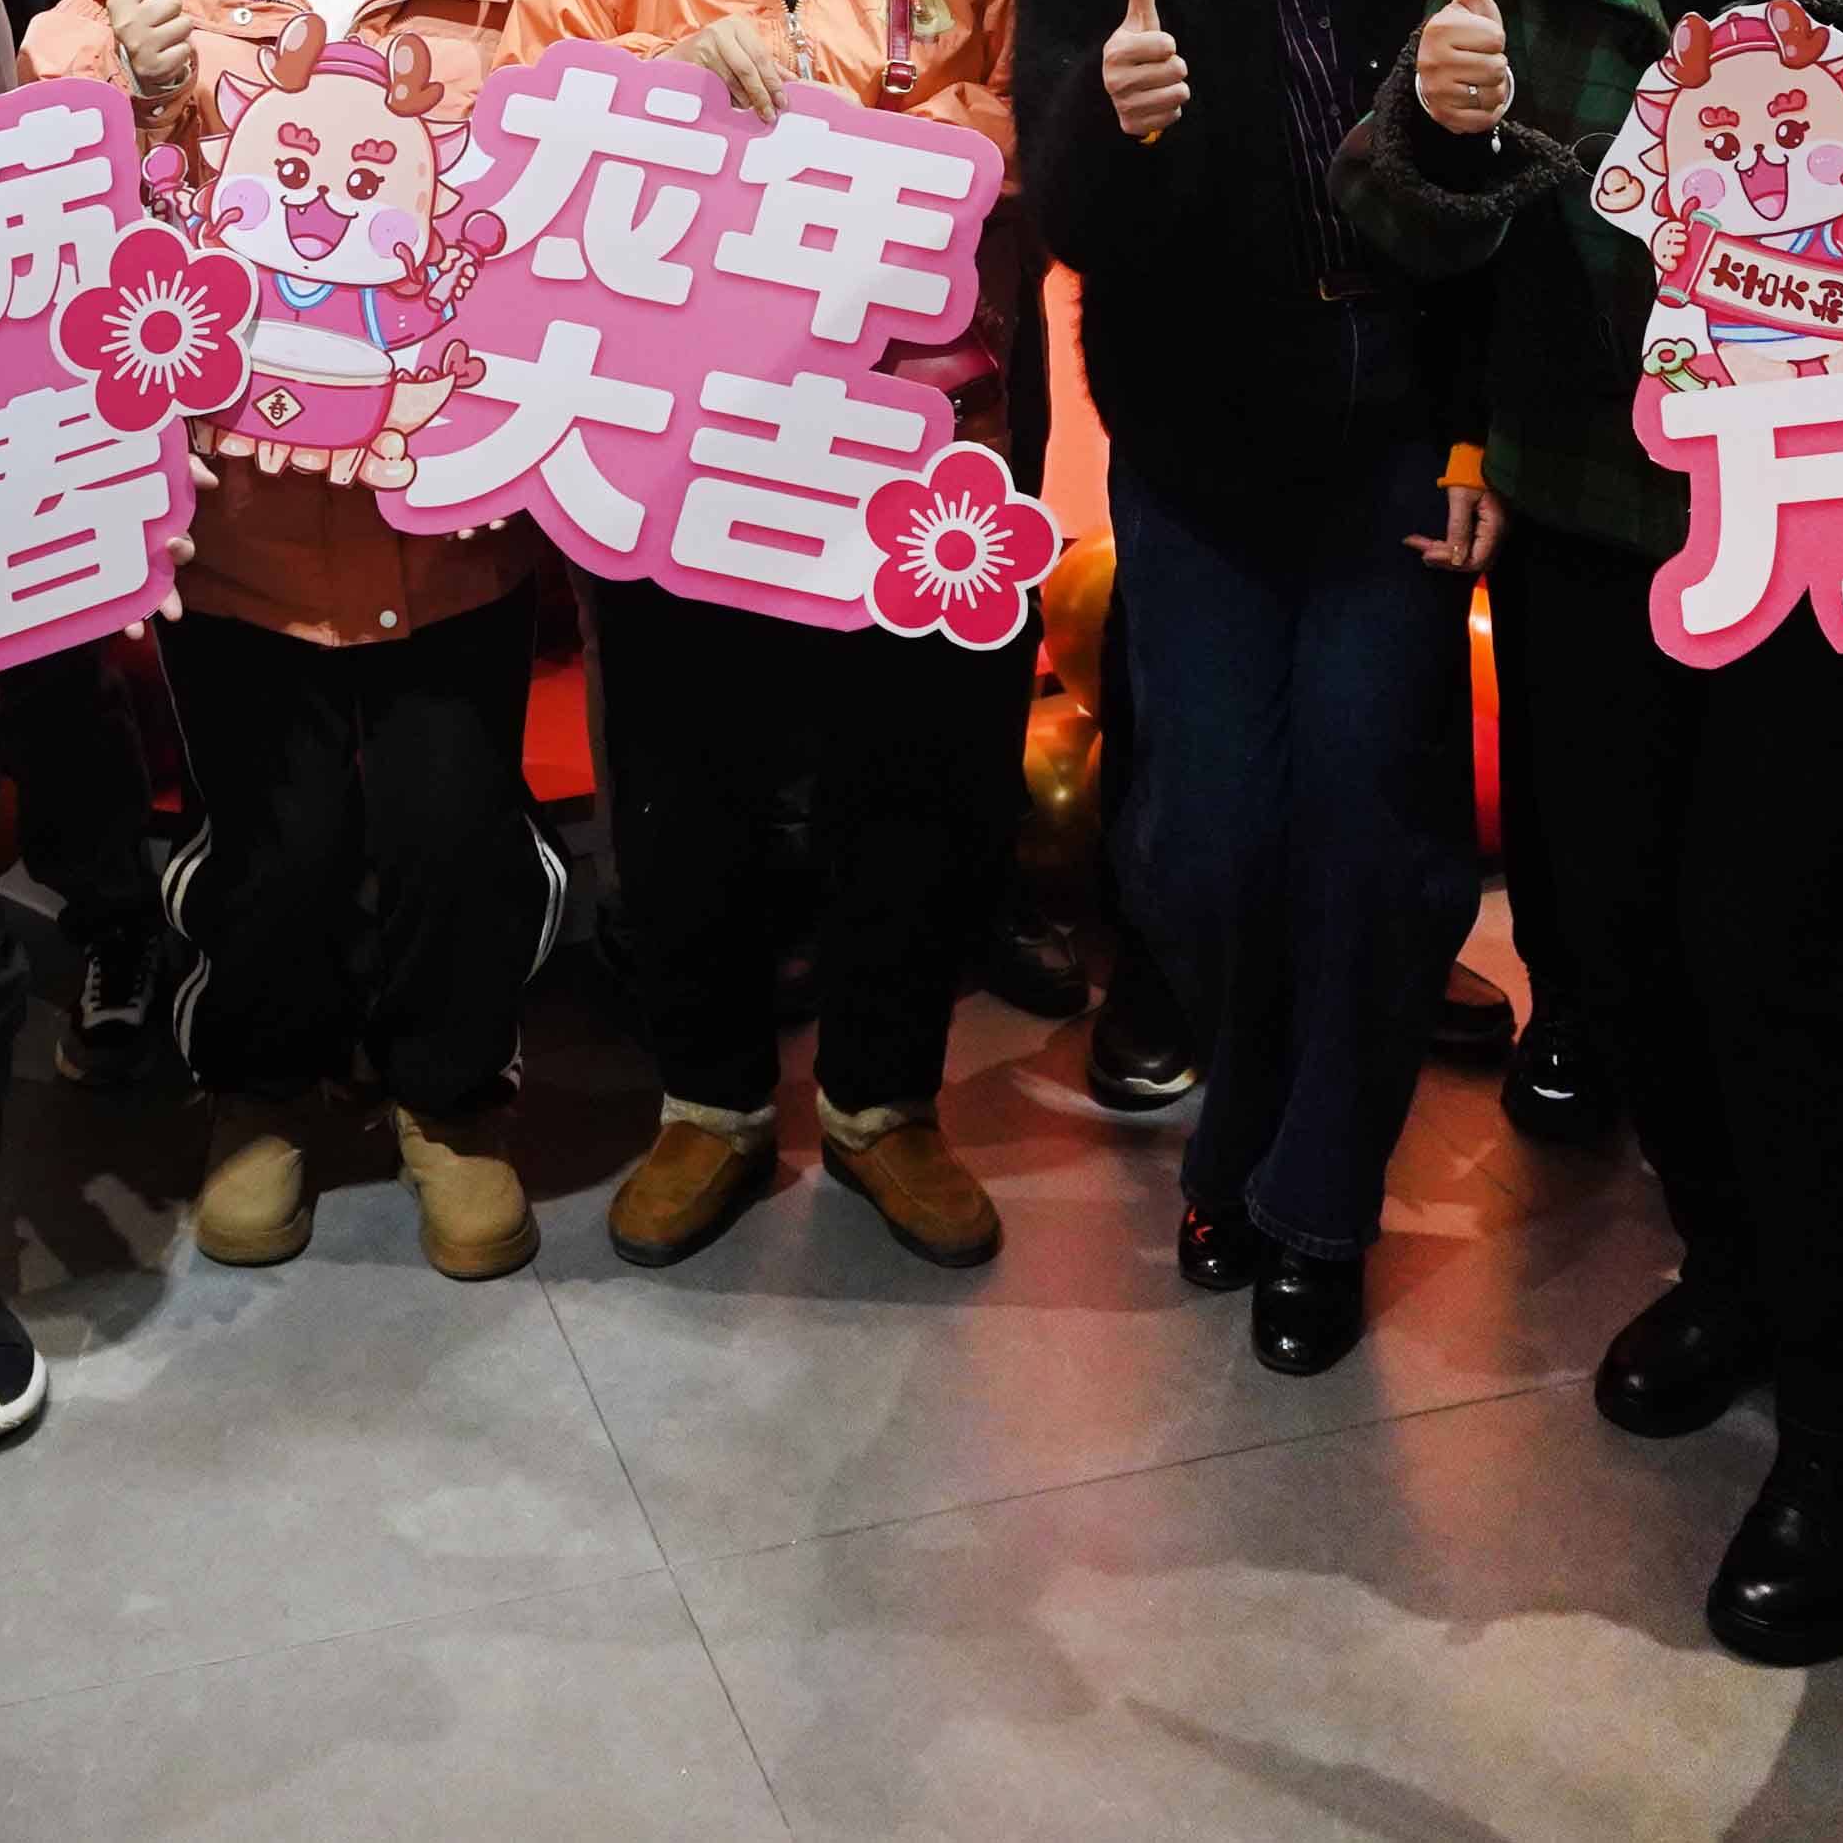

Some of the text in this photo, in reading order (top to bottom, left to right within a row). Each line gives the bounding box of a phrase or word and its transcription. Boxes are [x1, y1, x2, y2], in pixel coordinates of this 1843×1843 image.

[484, 66, 975, 346] 龙年
[267, 392, 289, 421] 春
[405, 319, 928, 604] 大吉
